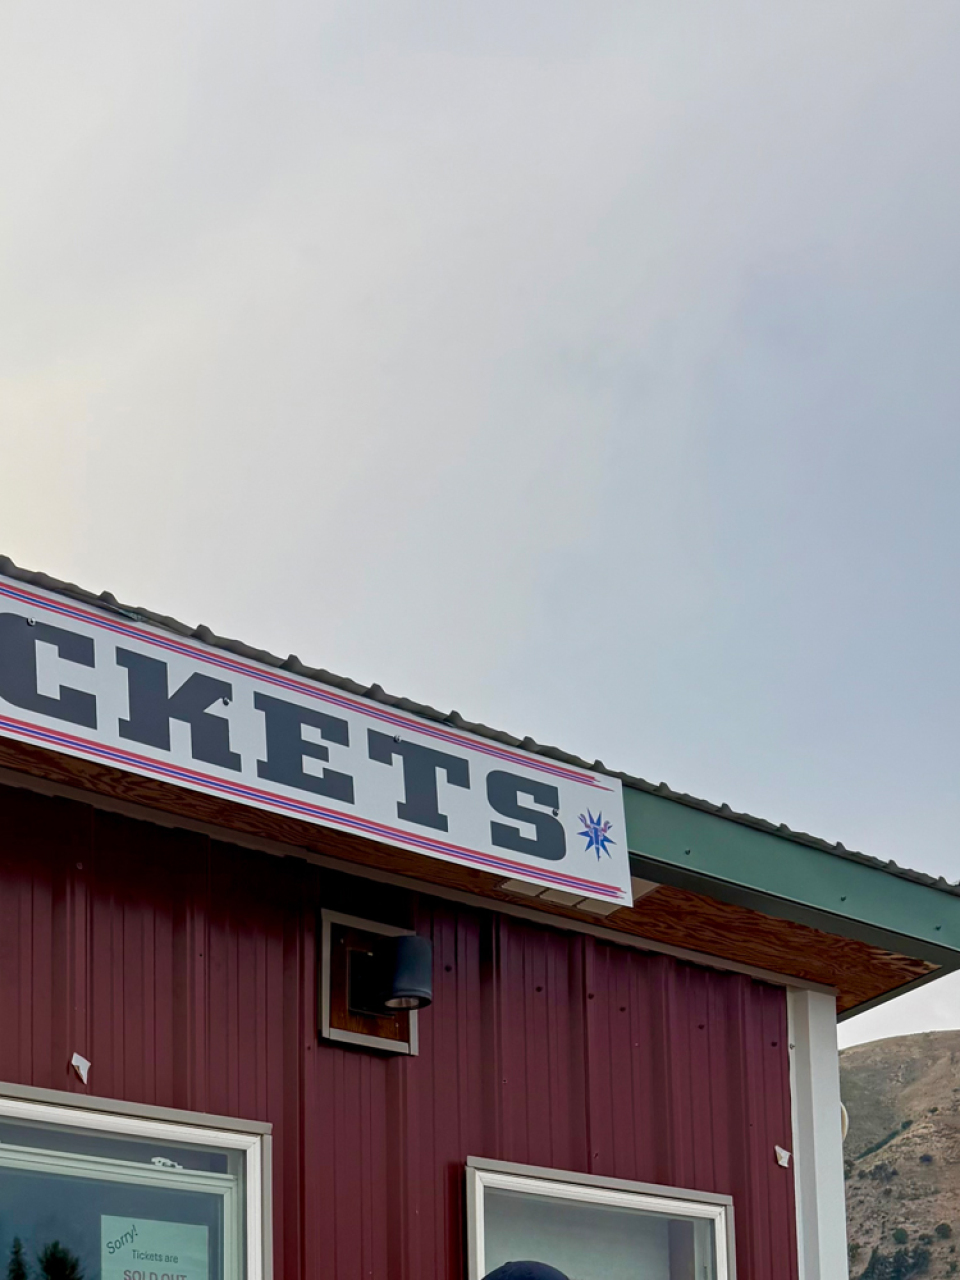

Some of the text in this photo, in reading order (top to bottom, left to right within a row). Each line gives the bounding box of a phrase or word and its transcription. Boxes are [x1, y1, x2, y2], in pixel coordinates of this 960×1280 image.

[106, 1224, 138, 1254] Sorry!
[132, 1249, 179, 1263] Tickets are
